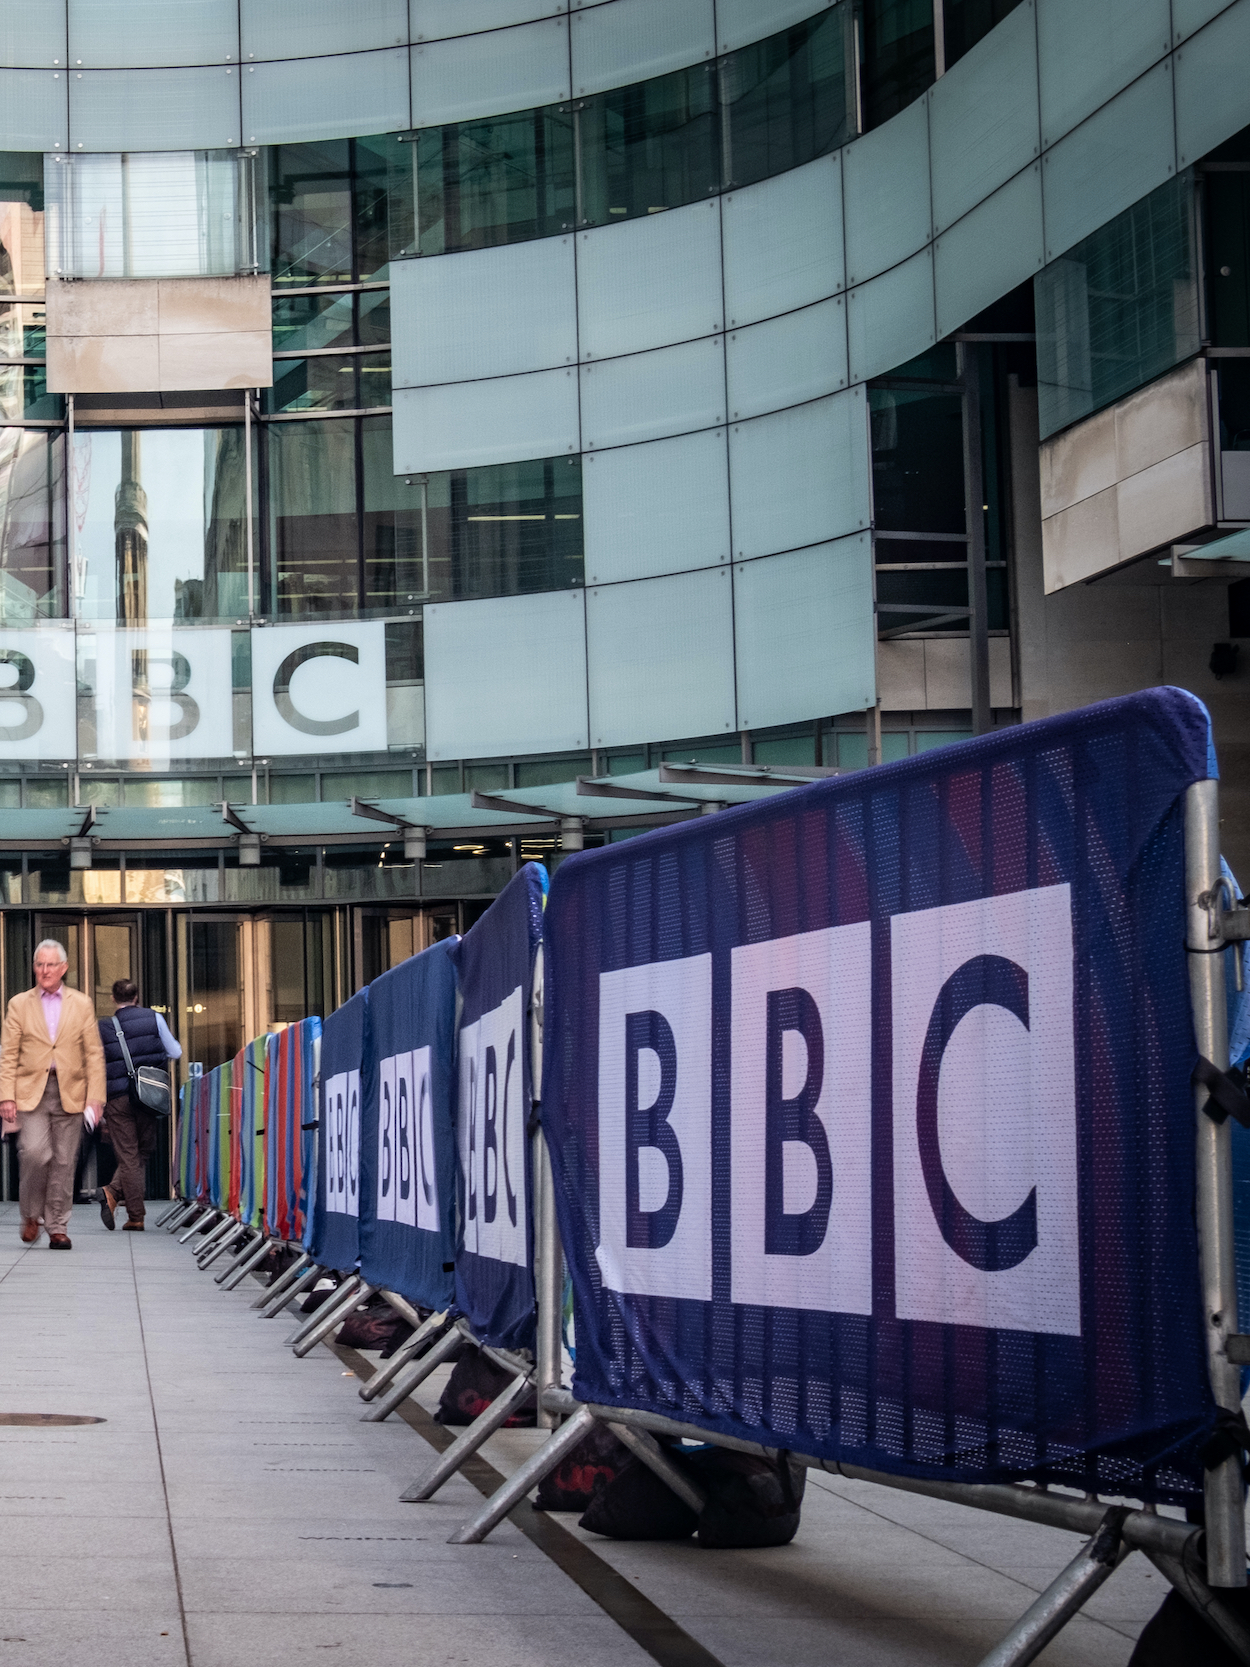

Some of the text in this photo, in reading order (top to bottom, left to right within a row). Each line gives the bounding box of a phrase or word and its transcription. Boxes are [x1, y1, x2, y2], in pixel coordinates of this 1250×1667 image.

[382, 1074, 433, 1206] BBC
[468, 1028, 517, 1228] BBC
[624, 953, 1039, 1273] BBC
